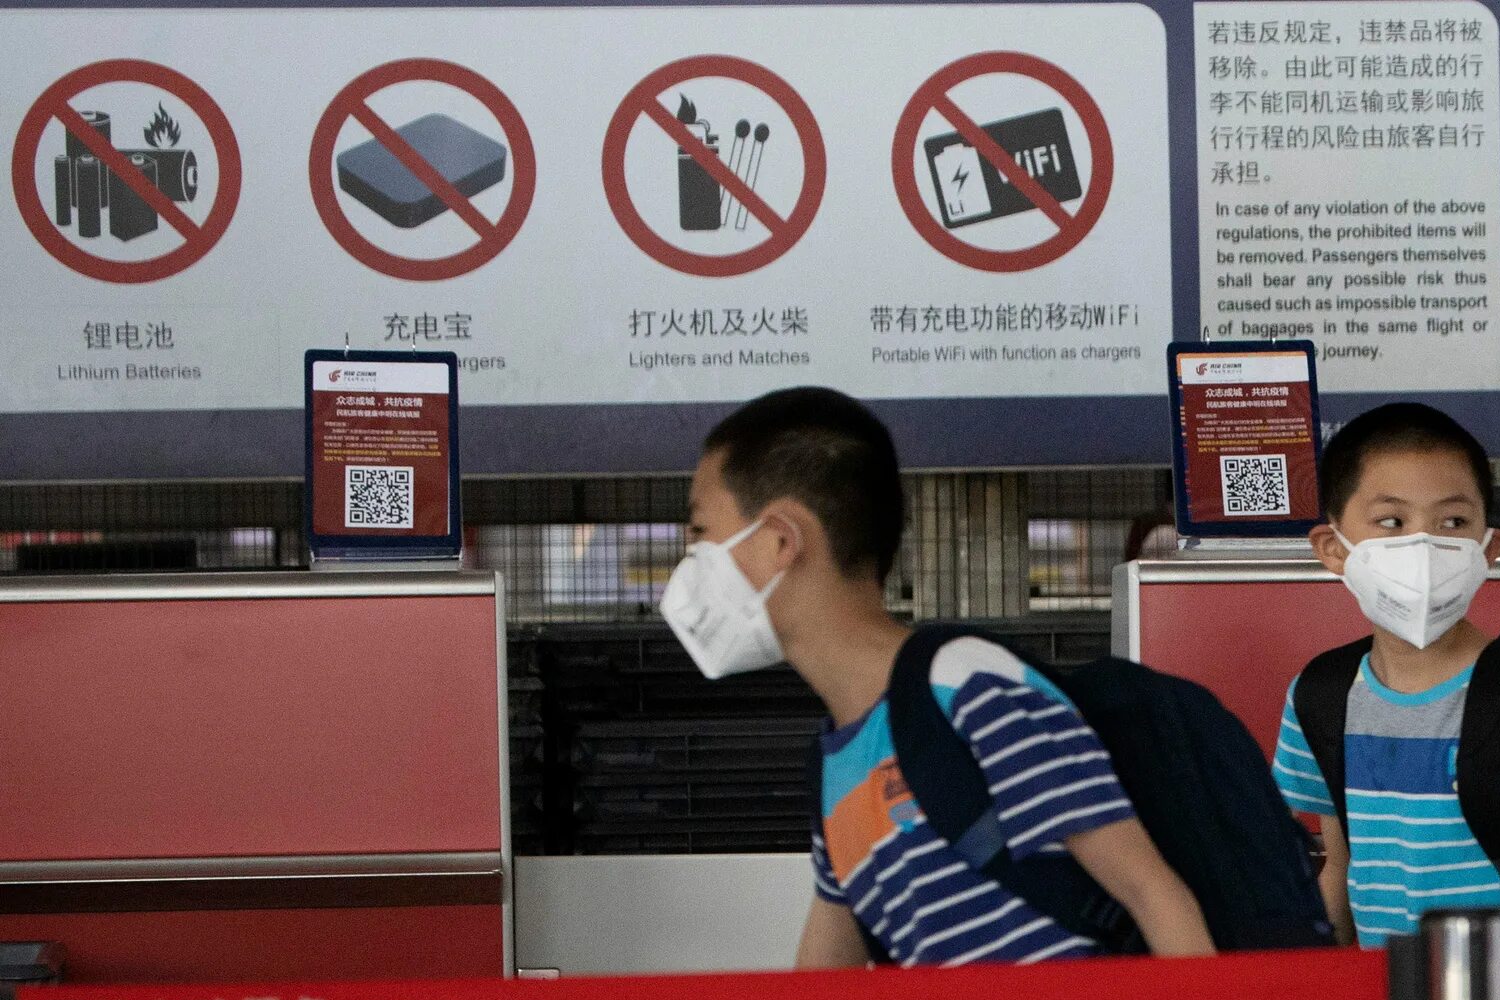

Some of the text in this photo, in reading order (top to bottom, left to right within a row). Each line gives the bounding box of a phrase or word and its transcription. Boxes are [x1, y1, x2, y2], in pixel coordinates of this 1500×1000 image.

[1208, 18, 1483, 45] 若违反规定，违禁品将被
[1208, 54, 1484, 80] 移除。由此可能造成的行
[1209, 88, 1485, 115] 李不能同机运输或影响旅
[1210, 123, 1486, 150] 行行程的风险由旅客自行
[1211, 161, 1272, 185] 承担。
[1216, 200, 1486, 219] In case of any violation of the above
[1216, 223, 1486, 244] regulations, the prohibited items will
[1217, 247, 1486, 267] be removed. Passengers themselves
[1217, 270, 1487, 291] shall bear any possible risk thus
[1218, 295, 1488, 314] caused such as impossible transport
[384, 311, 473, 341] 充电宝
[629, 307, 808, 336] 打火机及火柴
[870, 302, 1140, 333] 带有充电功能的移动WiFi
[83, 320, 174, 350] 锂电池
[1218, 319, 1488, 338] of baggages in the same flight or
[629, 349, 811, 369] Lighters and Matches
[872, 344, 1141, 363] Portable WiFi with function as chargers
[1323, 343, 1382, 361] journey.
[58, 363, 201, 380] Lithium Batteries
